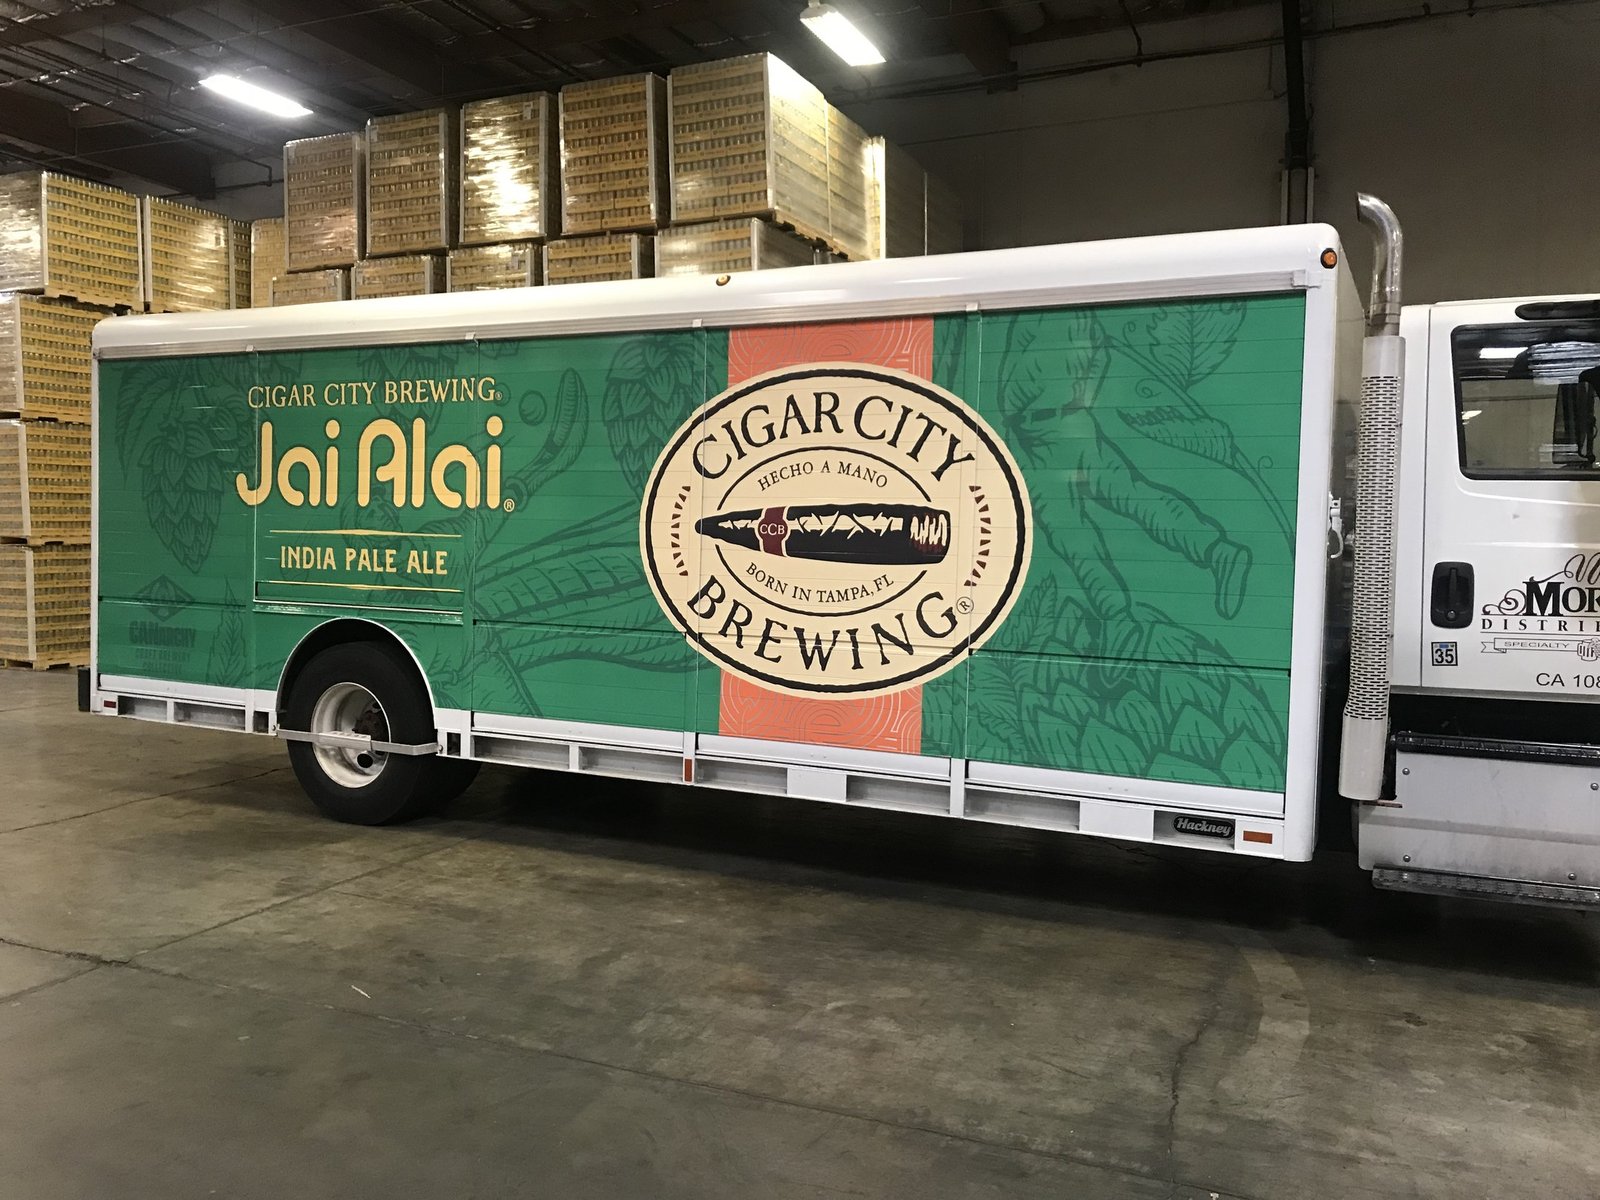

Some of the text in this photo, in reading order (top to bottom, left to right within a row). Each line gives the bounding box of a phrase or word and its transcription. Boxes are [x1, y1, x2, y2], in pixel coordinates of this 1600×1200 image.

[248, 384, 316, 408] CIGAR
[324, 381, 377, 406] CITY
[692, 391, 976, 482] CIGAR CITY
[235, 419, 341, 507] Jai
[757, 460, 889, 491] HECHO A MANO
[759, 523, 785, 536] CCB
[280, 545, 448, 575] INDIA PALE ALE
[746, 562, 788, 595] BORN
[792, 586, 812, 601] IN
[1434, 648, 1455, 664] 35
[1503, 640, 1570, 649] SPECIALTY
[1536, 672, 1565, 687] CA
[1176, 817, 1232, 837] Hackney
